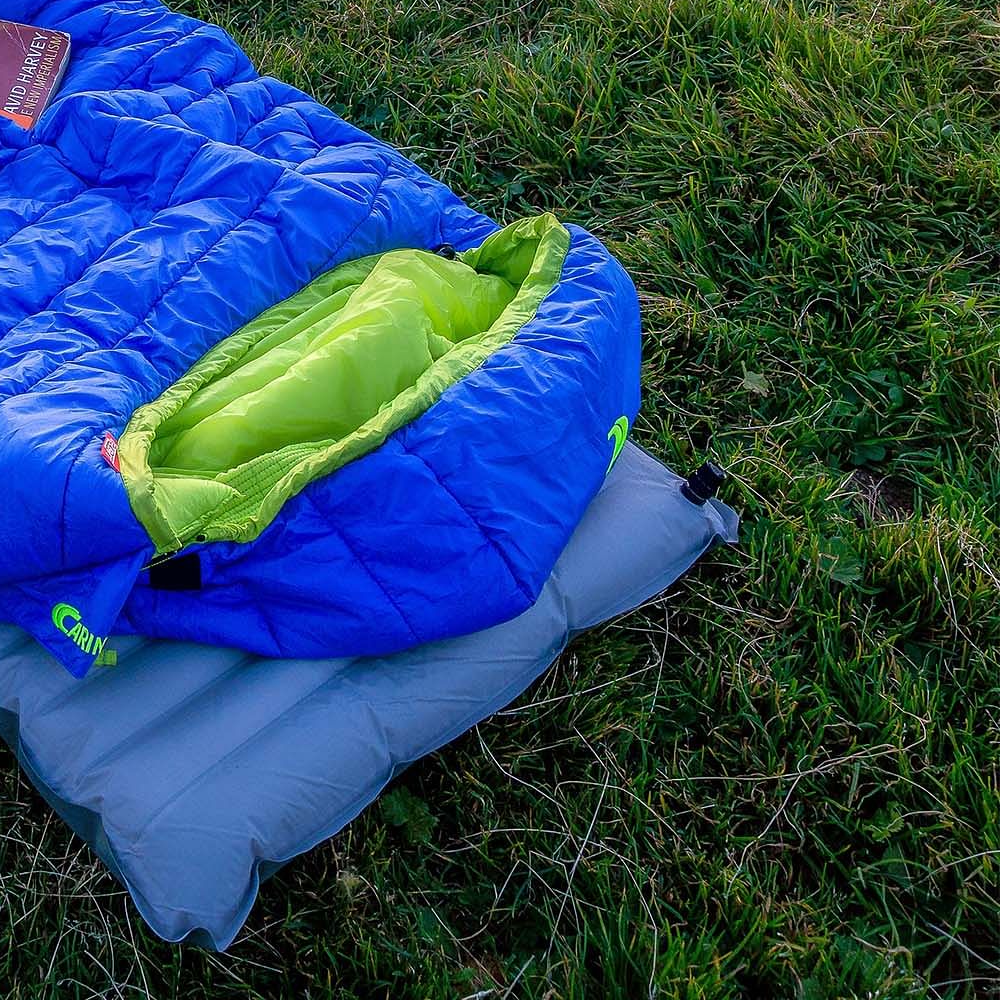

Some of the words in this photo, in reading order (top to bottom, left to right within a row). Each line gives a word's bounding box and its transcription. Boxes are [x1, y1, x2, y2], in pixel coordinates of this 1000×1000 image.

[17, 32, 48, 83] HARVEY
[32, 33, 62, 90] IMPERIALISM
[24, 90, 41, 110] NEW
